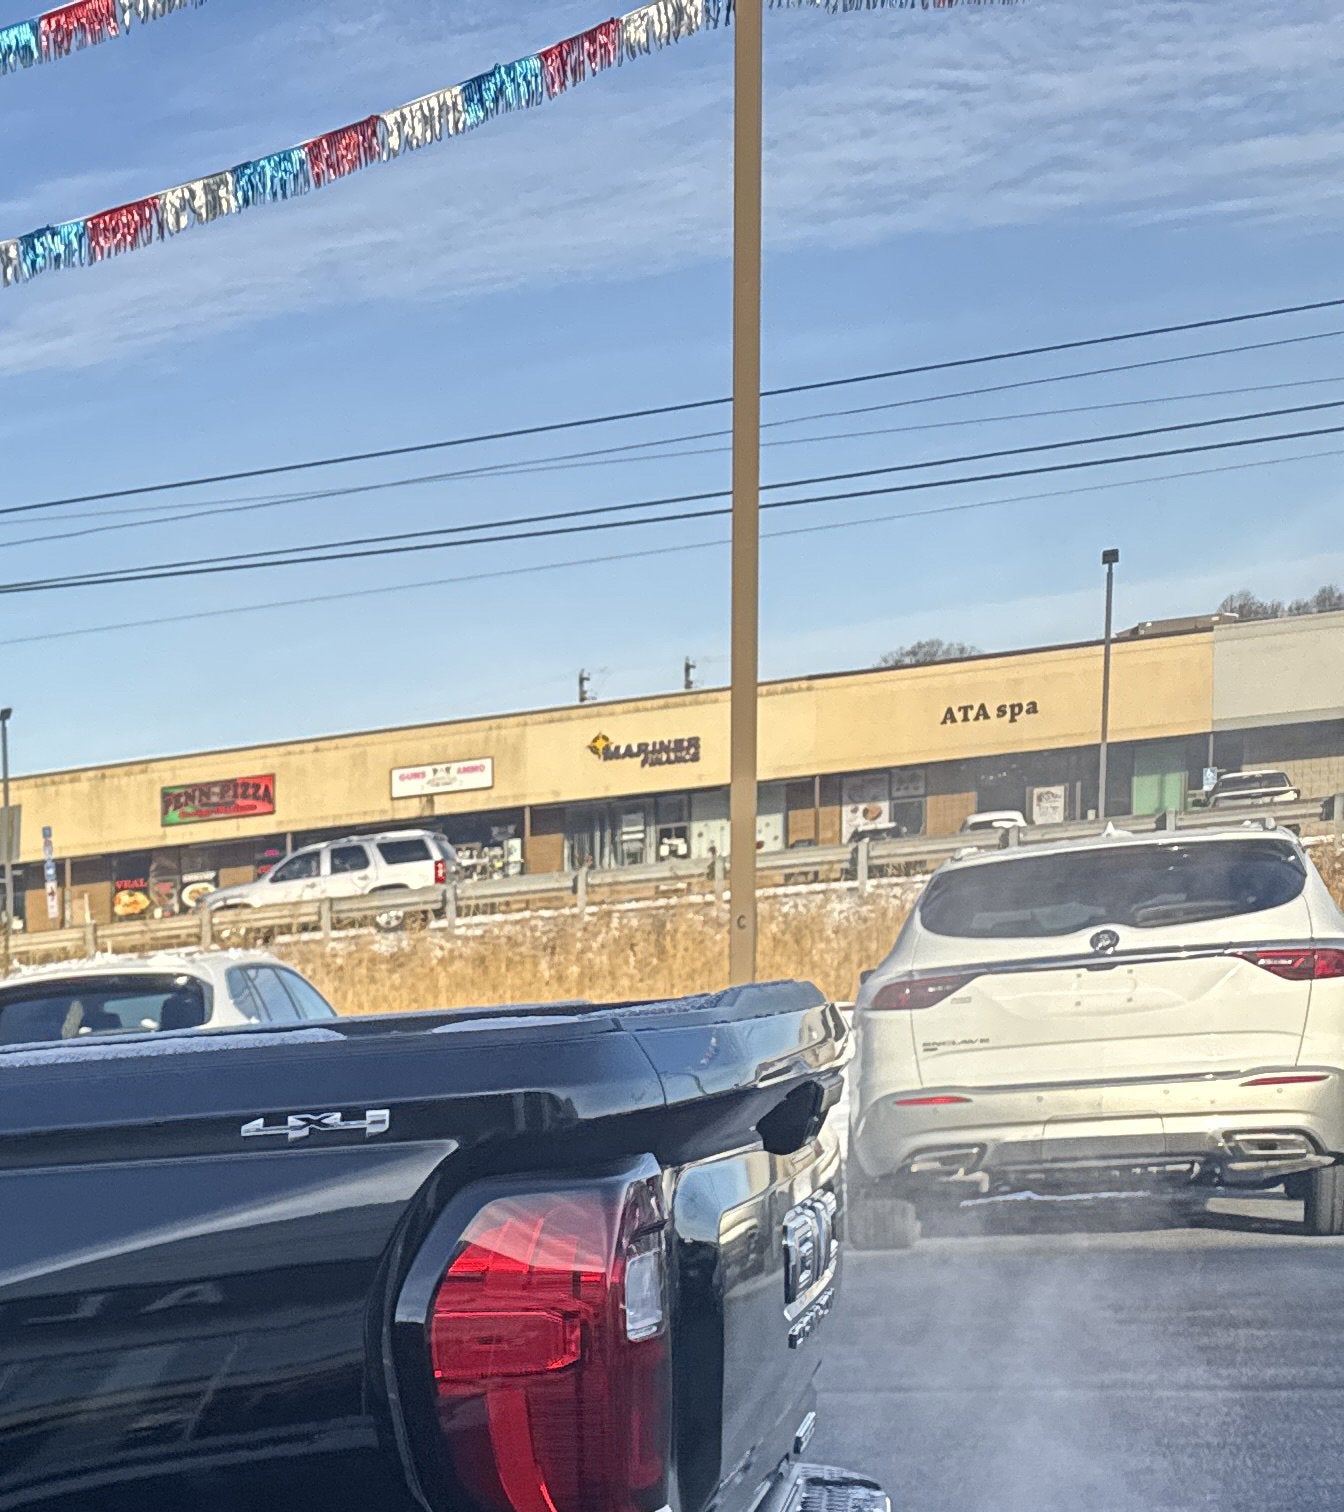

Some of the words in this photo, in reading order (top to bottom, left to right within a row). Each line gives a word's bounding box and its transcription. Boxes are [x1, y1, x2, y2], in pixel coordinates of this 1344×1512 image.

[940, 703, 991, 725] ATA
[996, 701, 1038, 723] spa
[602, 736, 700, 761] MARINER
[641, 750, 700, 768] FINANCE
